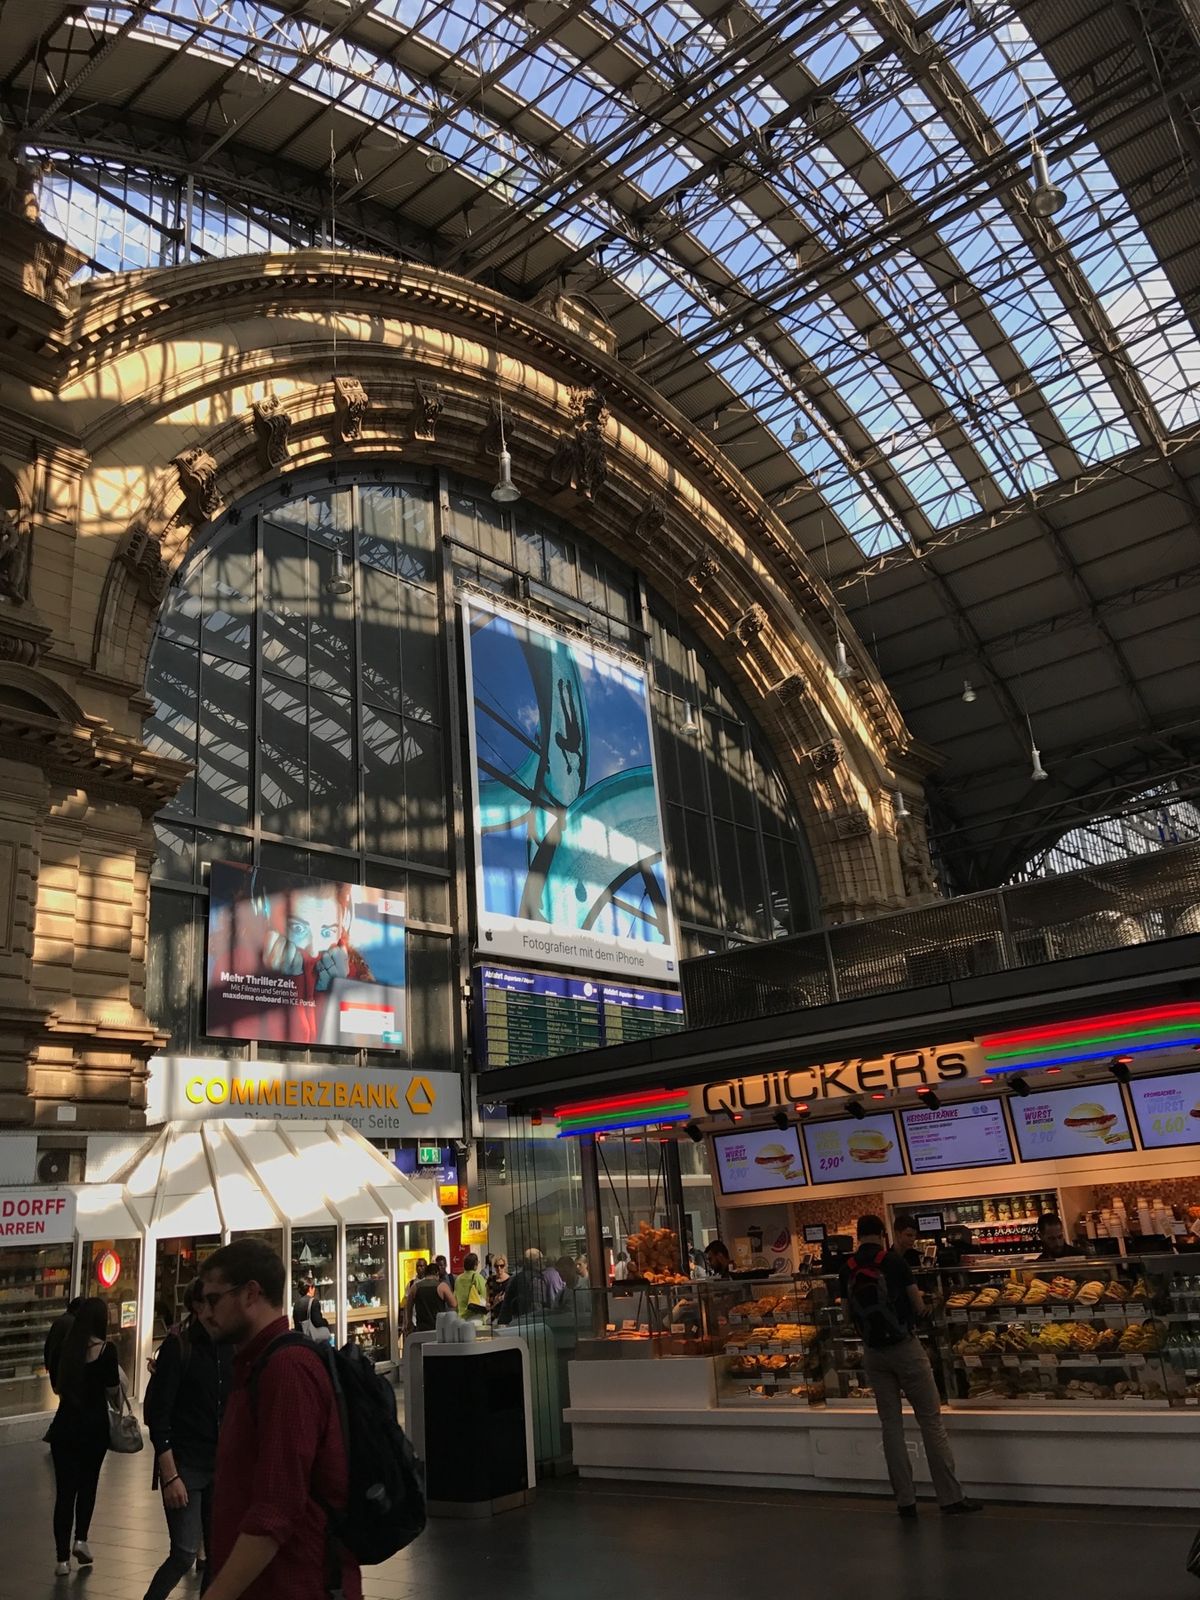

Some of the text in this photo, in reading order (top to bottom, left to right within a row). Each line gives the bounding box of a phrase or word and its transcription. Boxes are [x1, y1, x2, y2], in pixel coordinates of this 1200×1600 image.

[522, 935, 645, 967] Fotografiert mit dem iPhone
[220, 971, 245, 983] Mehr
[230, 984, 241, 992] Mit
[241, 985, 261, 994] Filmen
[261, 987, 272, 995] und
[272, 988, 289, 996] Serien
[222, 992, 254, 1001] maxdome
[255, 995, 282, 1004] onboard
[289, 998, 299, 1006] ICE
[186, 1076, 400, 1110] COMMERZBANK
[1147, 1100, 1185, 1114] WURST
[368, 1114, 400, 1129] Seite
[906, 1108, 959, 1122] HEISSGETRÄNKE
[1024, 1108, 1053, 1121] WURST
[725, 1148, 747, 1158] WURST
[2, 1198, 67, 1217] DORFF
